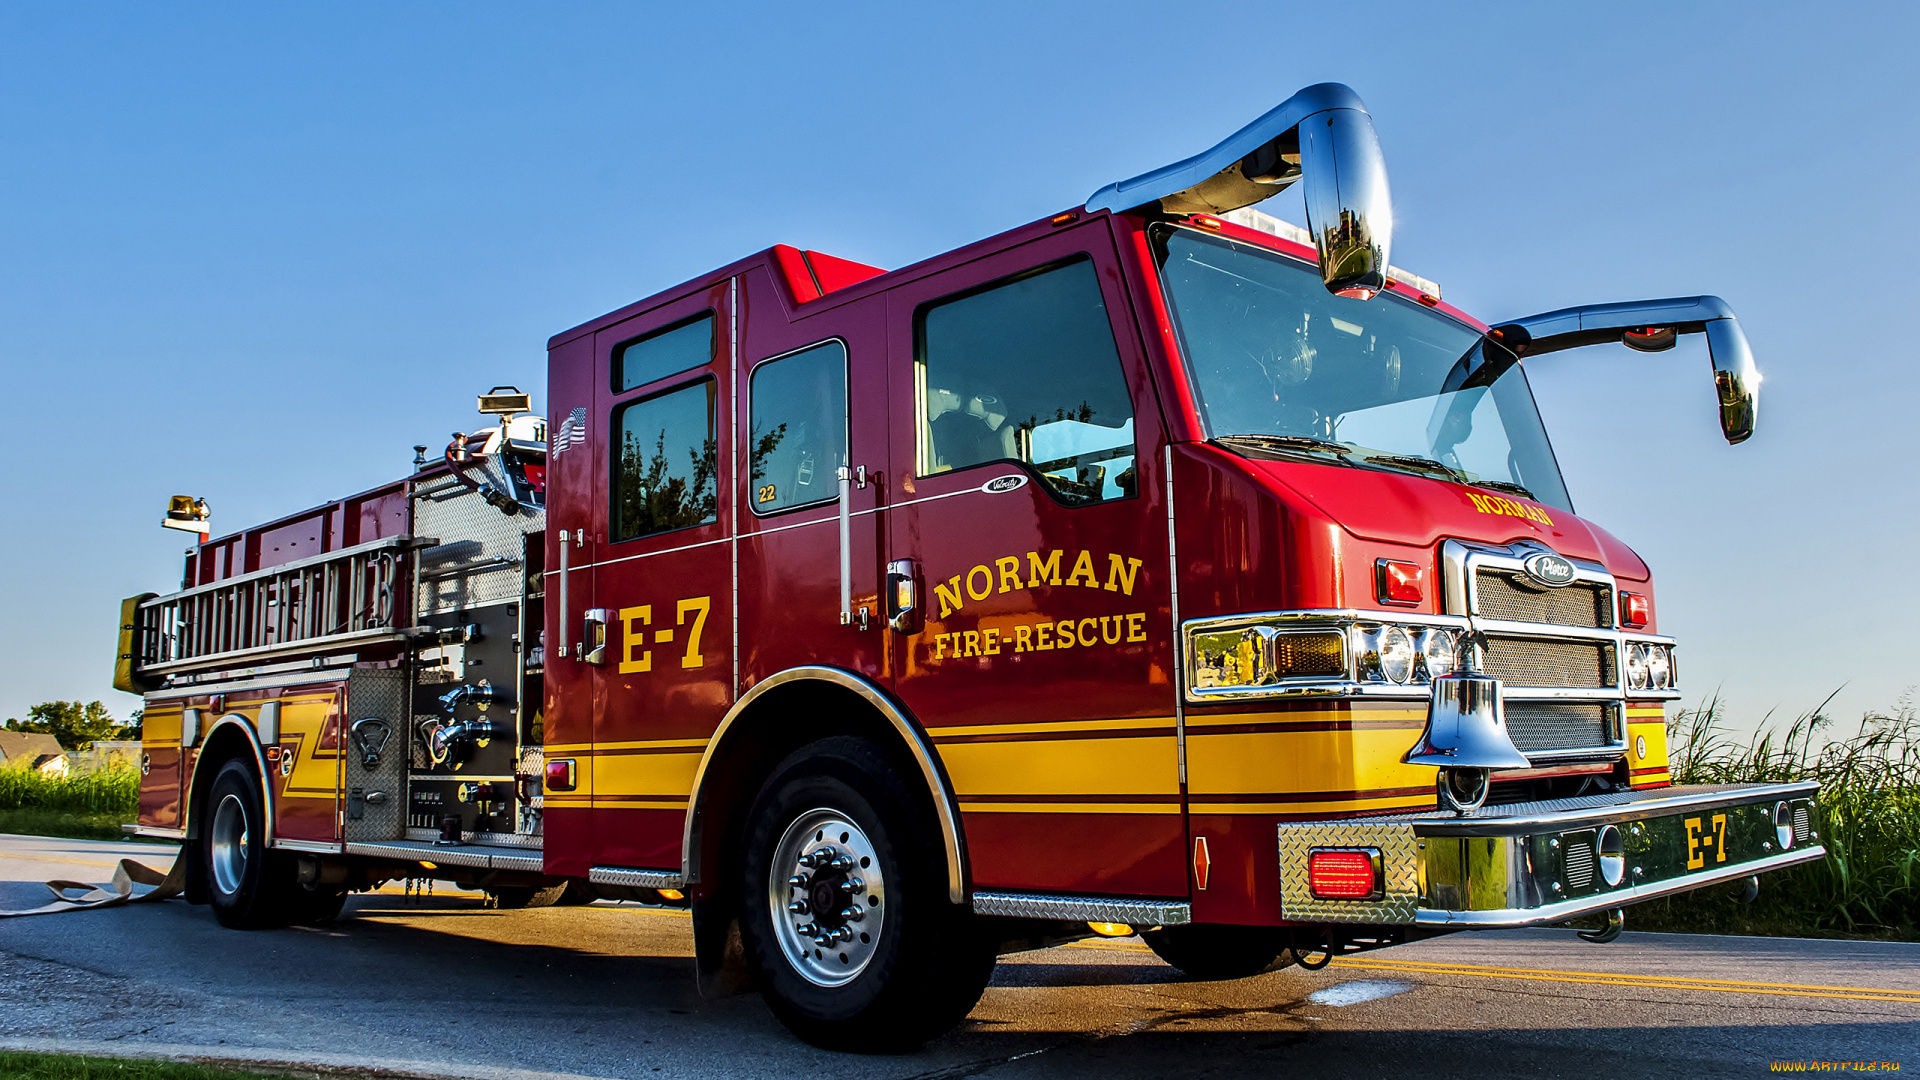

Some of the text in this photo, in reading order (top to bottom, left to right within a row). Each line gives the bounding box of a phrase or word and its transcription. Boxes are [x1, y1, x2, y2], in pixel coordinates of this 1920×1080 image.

[759, 485, 775, 503] 22
[993, 478, 1017, 490] Velocity
[1466, 492, 1554, 527] NORMAN
[933, 549, 1143, 619] NORMAN
[1541, 557, 1570, 577] Pierce
[618, 595, 711, 675] E-7
[934, 612, 1147, 660] FIRE-RESCUE
[1684, 813, 1727, 871] E-7
